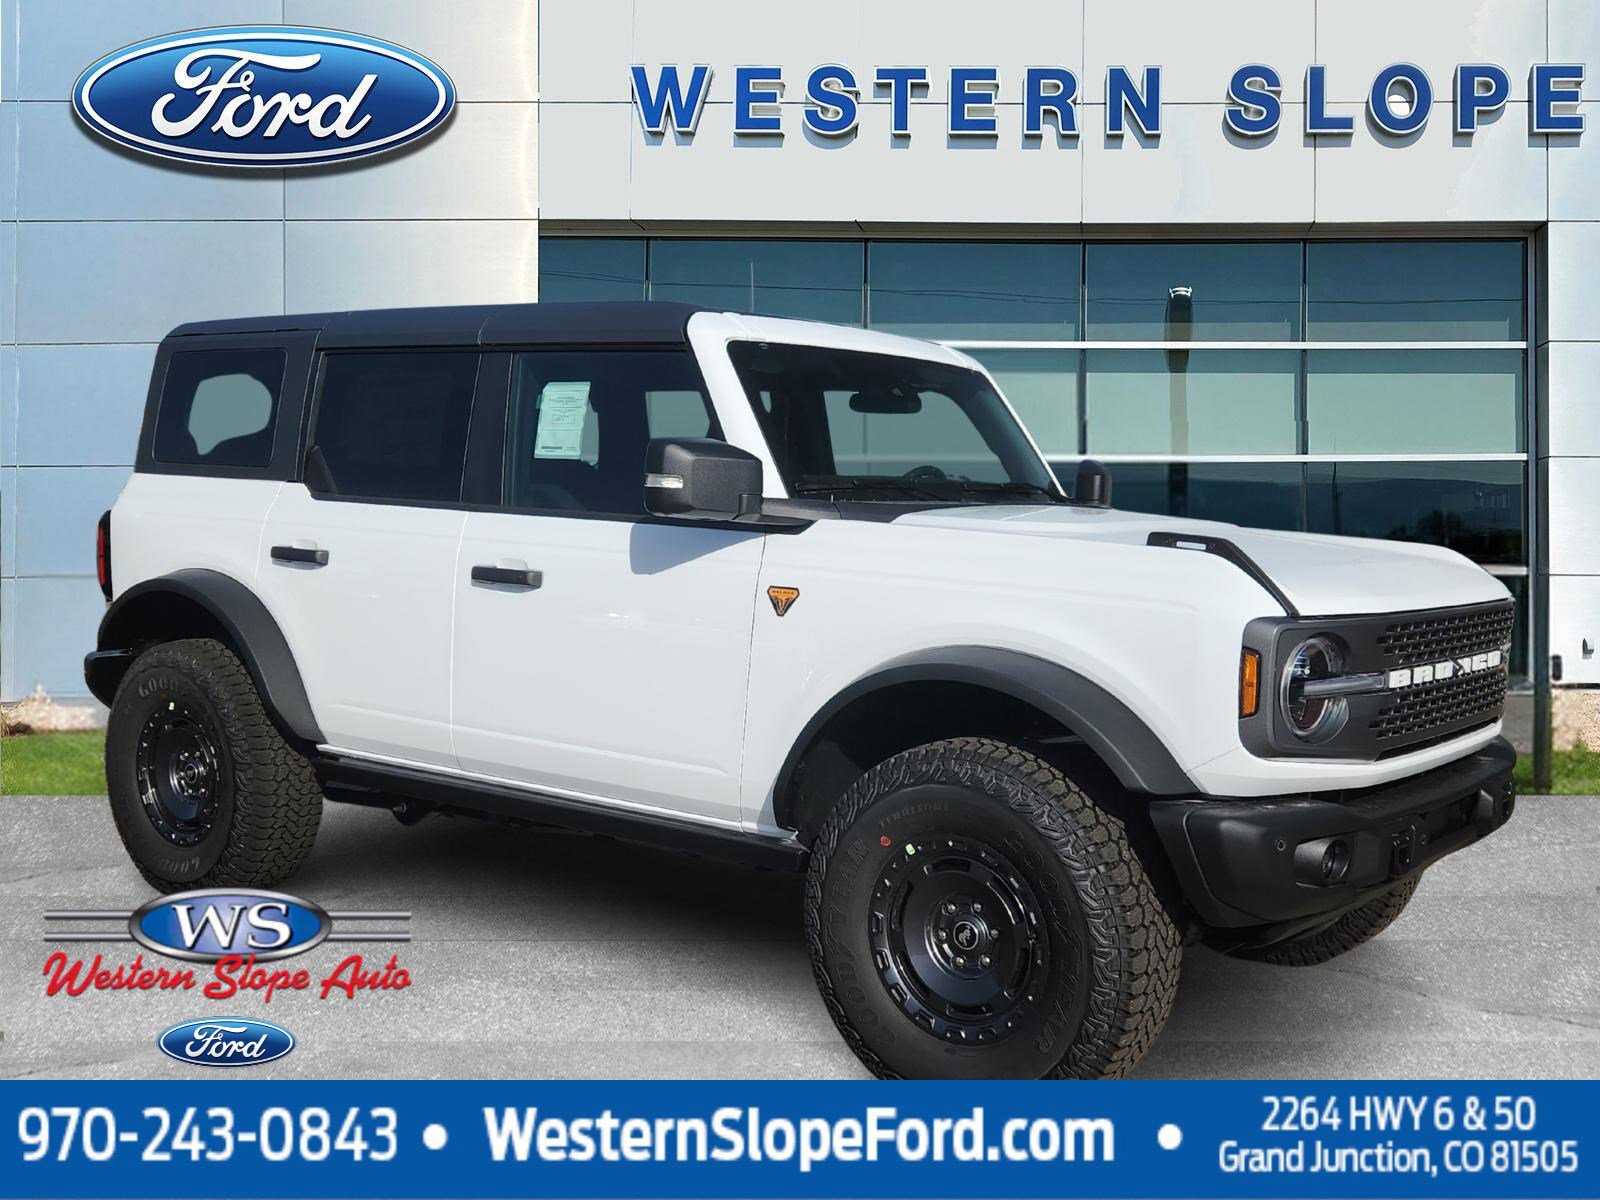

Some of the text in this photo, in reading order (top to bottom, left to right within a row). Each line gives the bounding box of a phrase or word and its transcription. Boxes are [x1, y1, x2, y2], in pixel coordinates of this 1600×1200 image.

[150, 47, 378, 139] Ford
[630, 62, 1586, 137] WESTERN SLOPE
